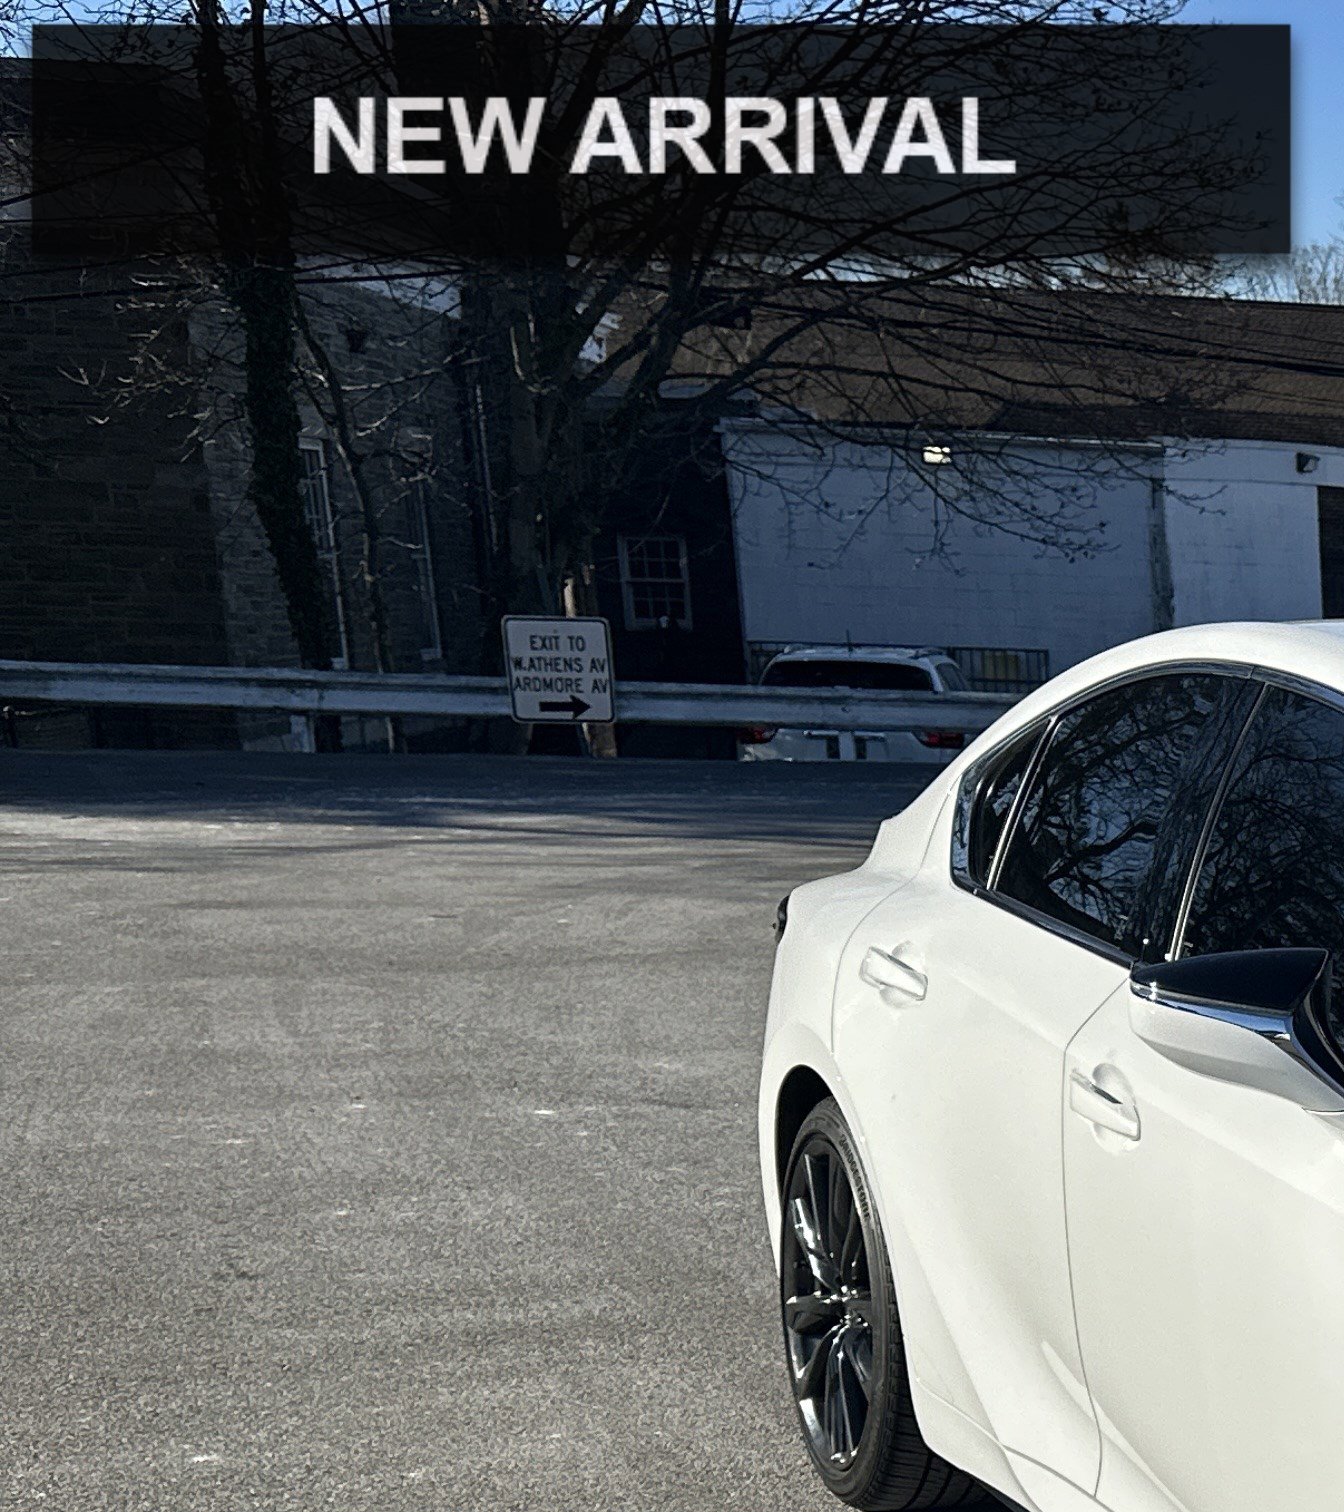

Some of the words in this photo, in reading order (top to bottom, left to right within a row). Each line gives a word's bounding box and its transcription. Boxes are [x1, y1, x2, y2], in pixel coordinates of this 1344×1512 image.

[529, 635, 560, 651] EXIT
[567, 635, 586, 652] TO
[590, 657, 606, 673] AV
[513, 676, 584, 694] ARDMORE
[591, 678, 608, 694] AV
